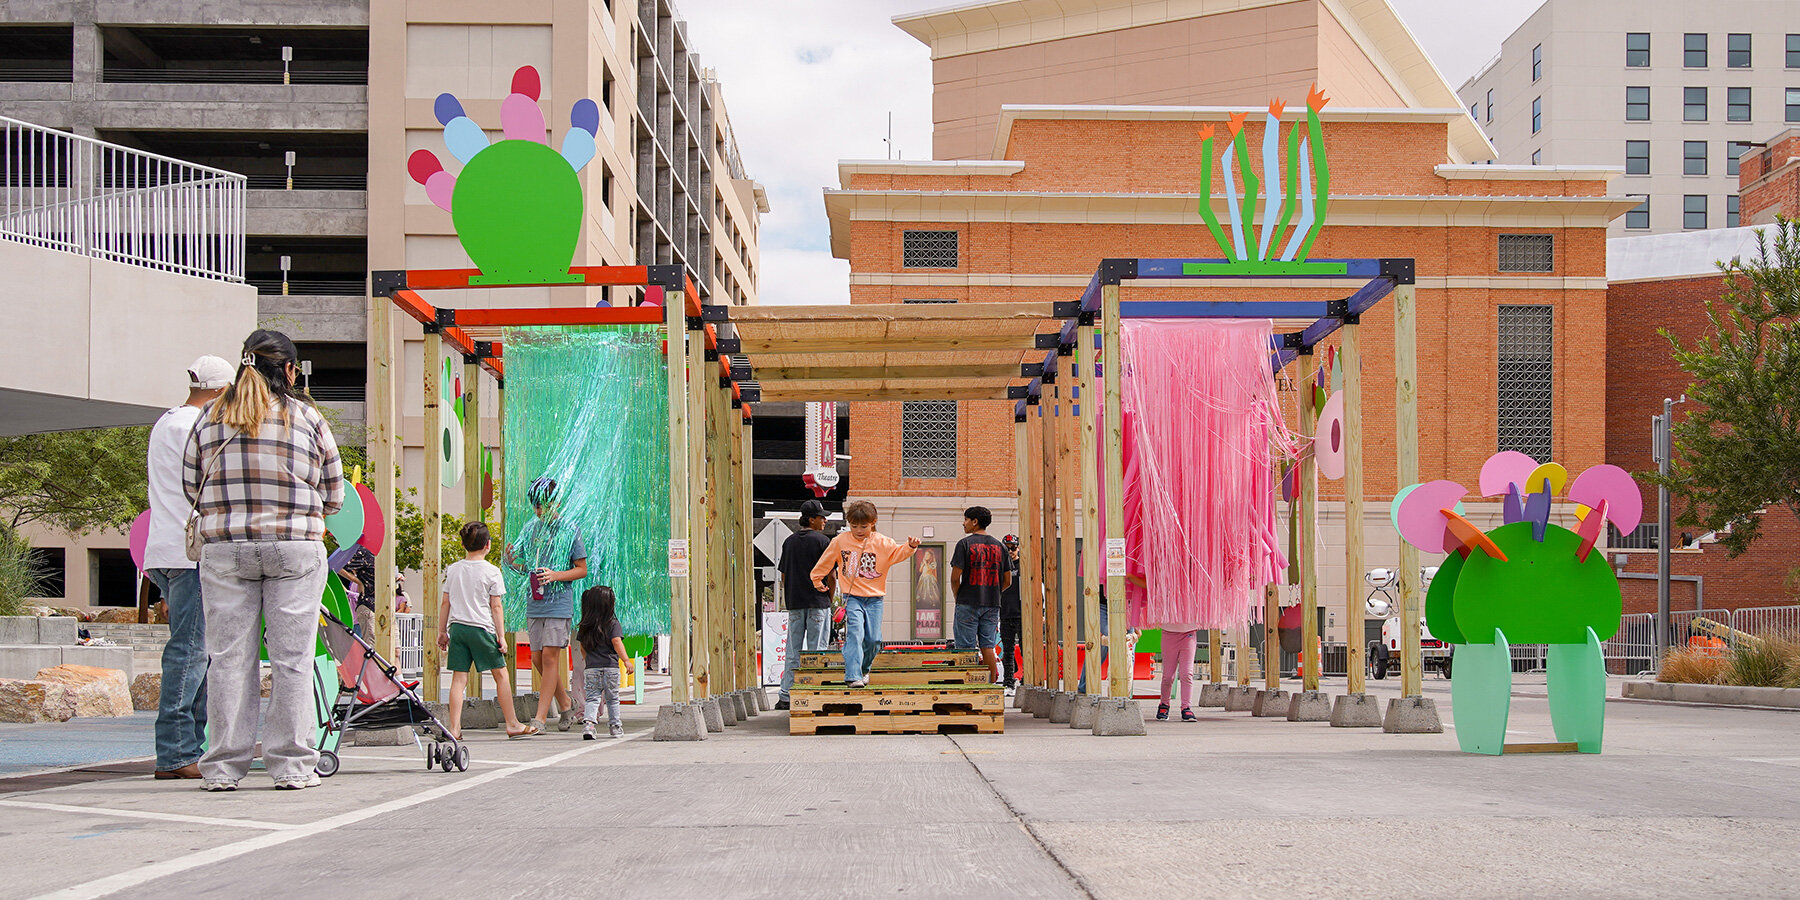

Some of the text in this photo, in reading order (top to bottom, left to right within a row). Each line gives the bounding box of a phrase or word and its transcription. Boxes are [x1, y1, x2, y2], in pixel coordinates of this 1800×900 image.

[824, 402, 832, 463] AZA
[816, 472, 838, 482] Theatre
[920, 612, 935, 620] AM
[916, 620, 941, 628] PLAZA
